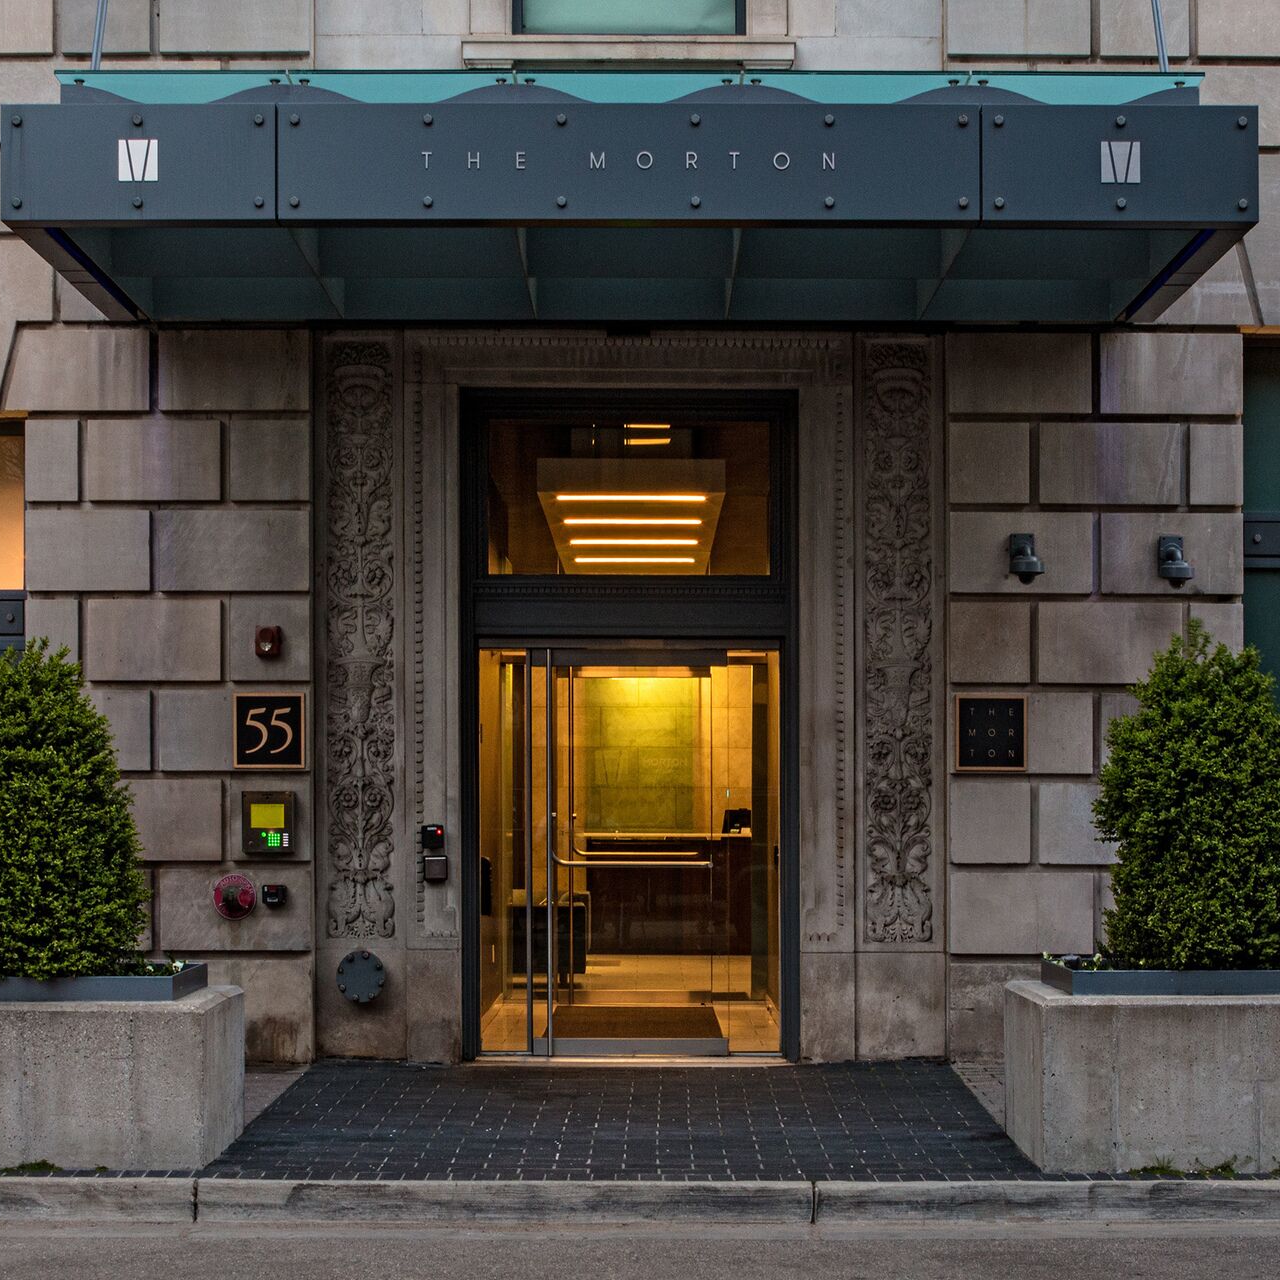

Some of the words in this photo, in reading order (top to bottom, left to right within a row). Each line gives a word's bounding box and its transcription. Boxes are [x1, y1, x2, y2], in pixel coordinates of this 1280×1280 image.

[421, 151, 527, 169] THE
[590, 151, 835, 170] MORTON
[969, 708, 1014, 716] THE
[245, 707, 294, 754] 55
[969, 729, 1014, 737] MOR
[969, 749, 1014, 757] TON
